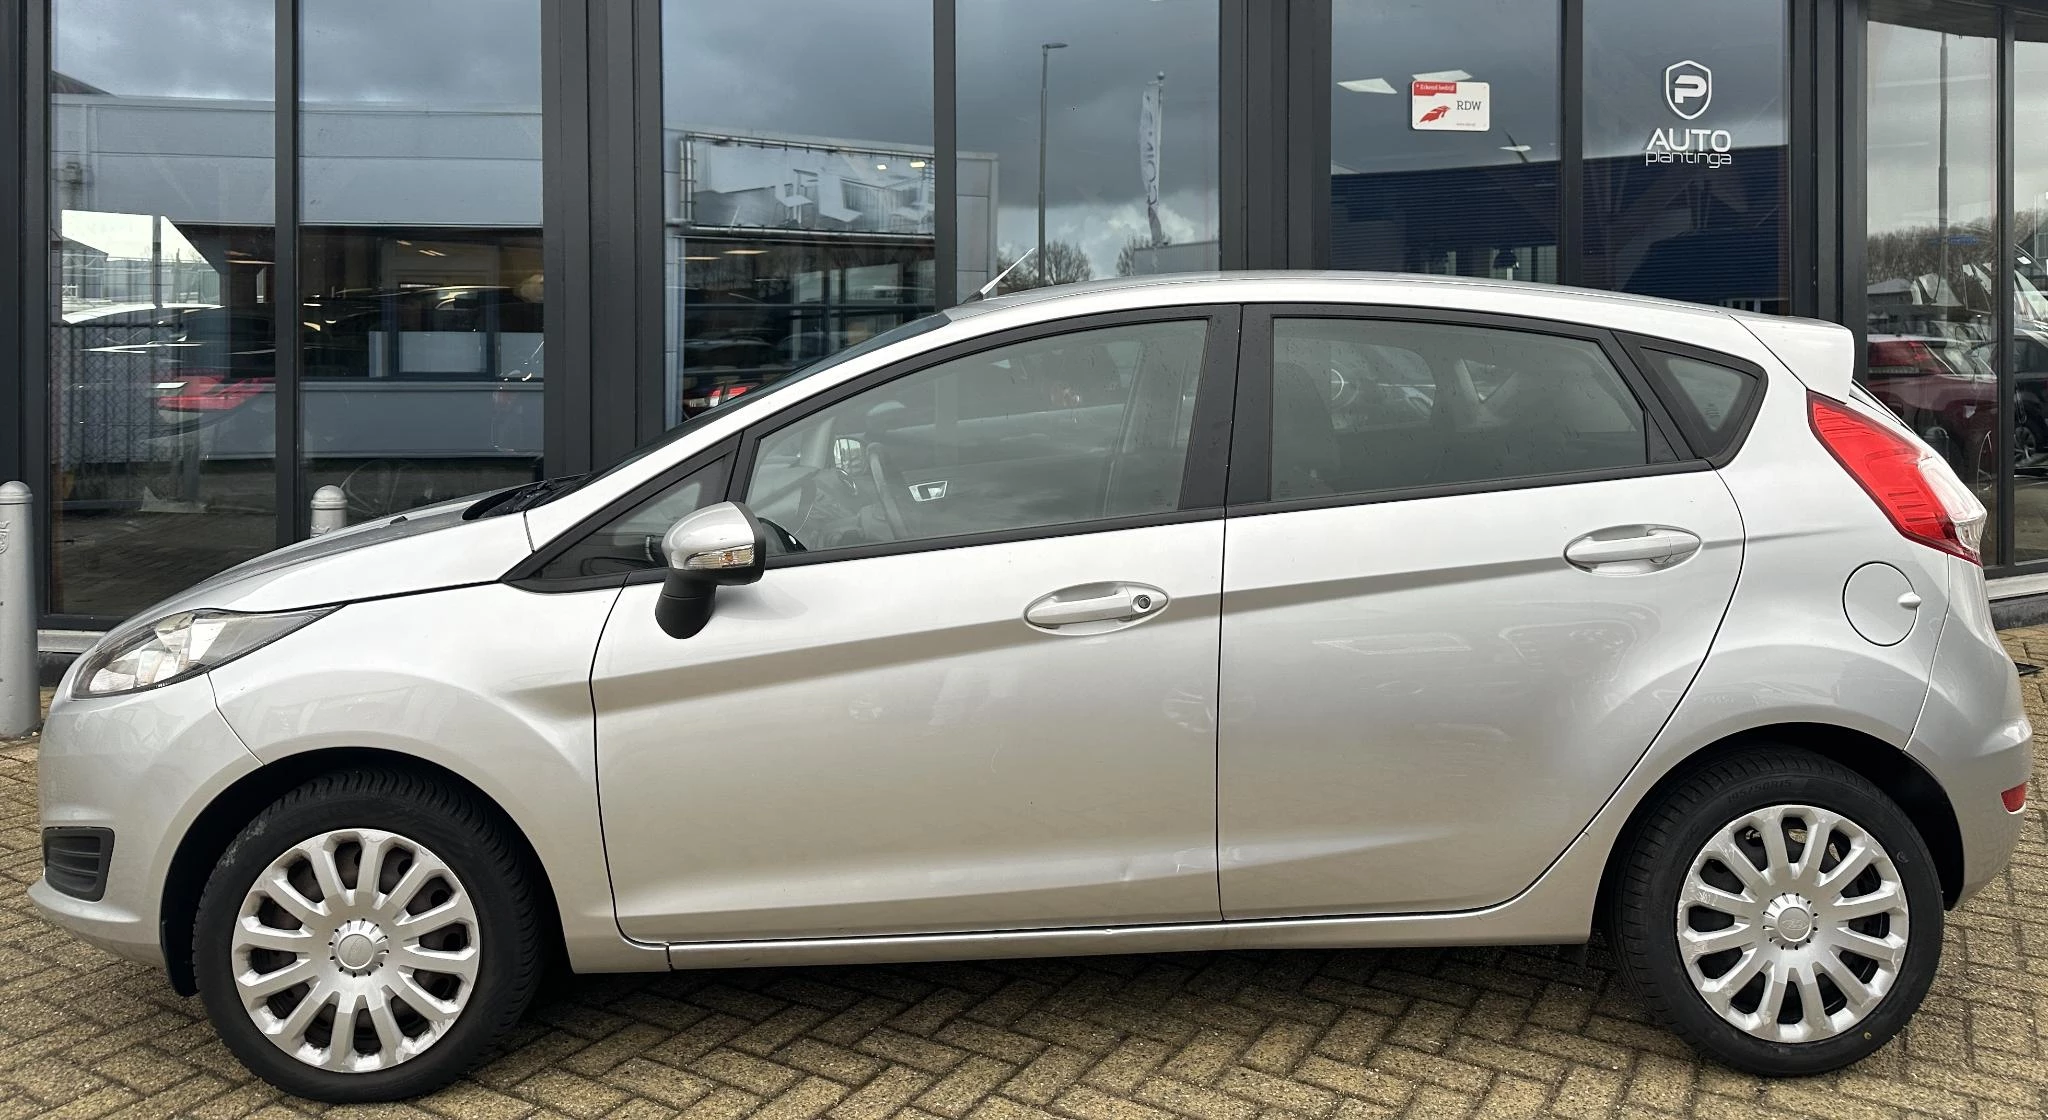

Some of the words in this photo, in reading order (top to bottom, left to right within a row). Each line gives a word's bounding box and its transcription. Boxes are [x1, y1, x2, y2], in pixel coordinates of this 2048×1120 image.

[1674, 74, 1707, 104] P
[1456, 100, 1482, 111] RDW
[1646, 127, 1732, 152] AUTO
[1645, 150, 1732, 169] plantinga
